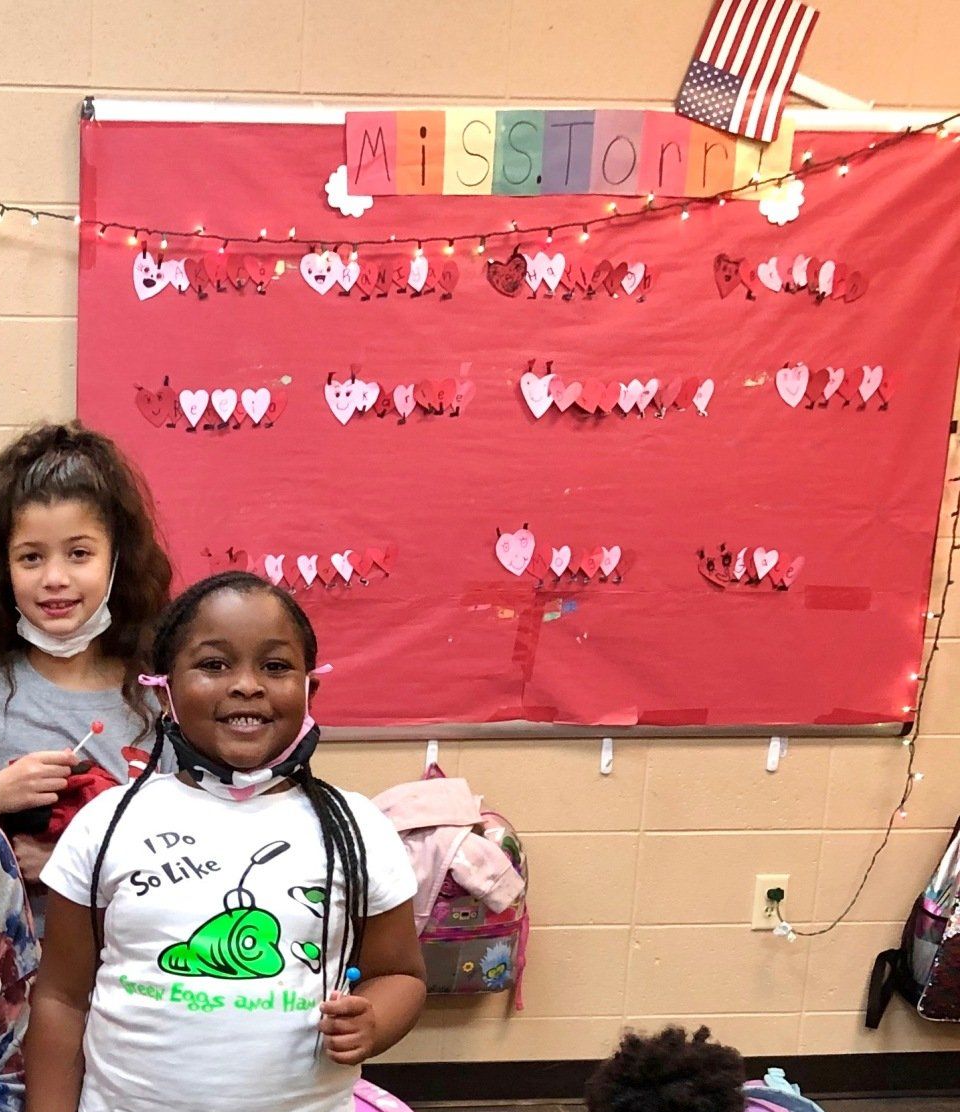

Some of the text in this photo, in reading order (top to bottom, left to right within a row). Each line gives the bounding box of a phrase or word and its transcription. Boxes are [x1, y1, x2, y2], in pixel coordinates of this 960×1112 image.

[144, 831, 196, 854] I Do
[130, 856, 221, 896] So Like
[170, 982, 225, 1013] Eggs
